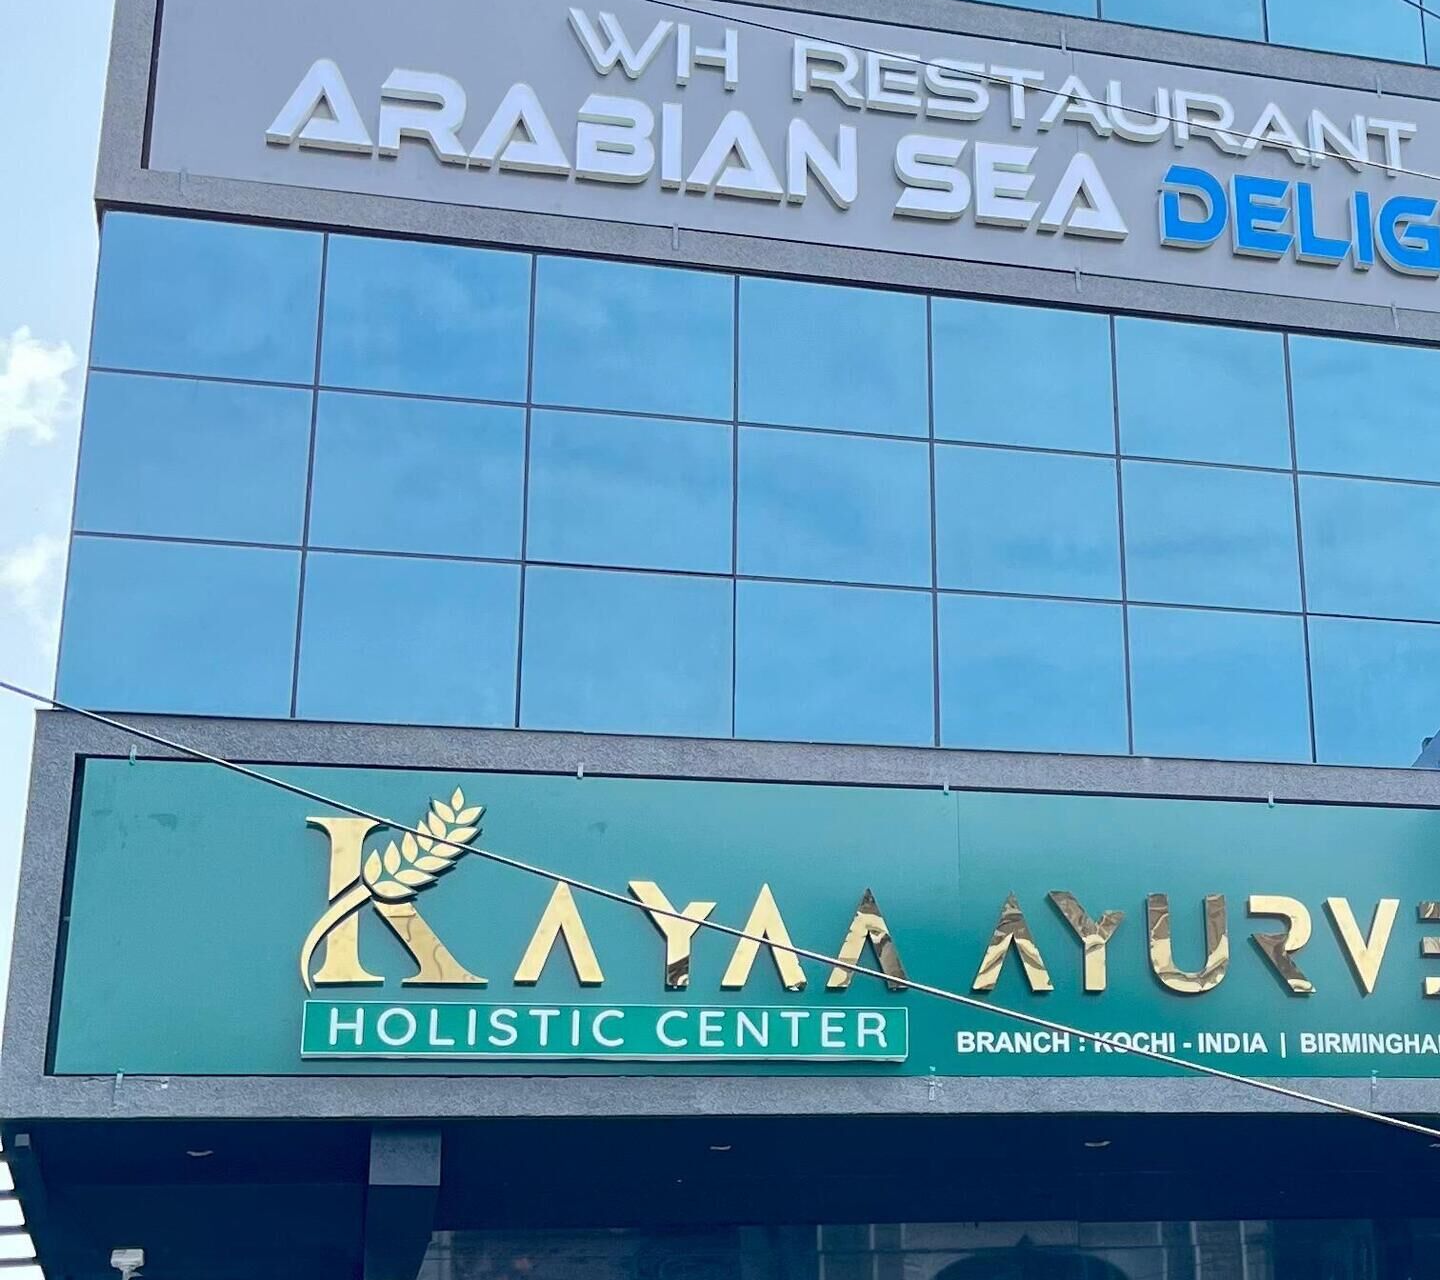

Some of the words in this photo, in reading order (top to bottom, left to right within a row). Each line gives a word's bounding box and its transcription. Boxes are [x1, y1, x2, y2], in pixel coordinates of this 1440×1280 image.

[568, 6, 740, 92] WH
[792, 36, 1418, 177] RESTAURANT
[264, 57, 859, 210] ARABIAN
[893, 133, 1129, 241] SEA
[328, 1006, 625, 1048] HOLISTIC
[656, 1009, 888, 1049] CENTER
[956, 1031, 1071, 1054] BRANCH
[1092, 1032, 1177, 1055] KOCHI
[1199, 1033, 1268, 1055] INDIA
